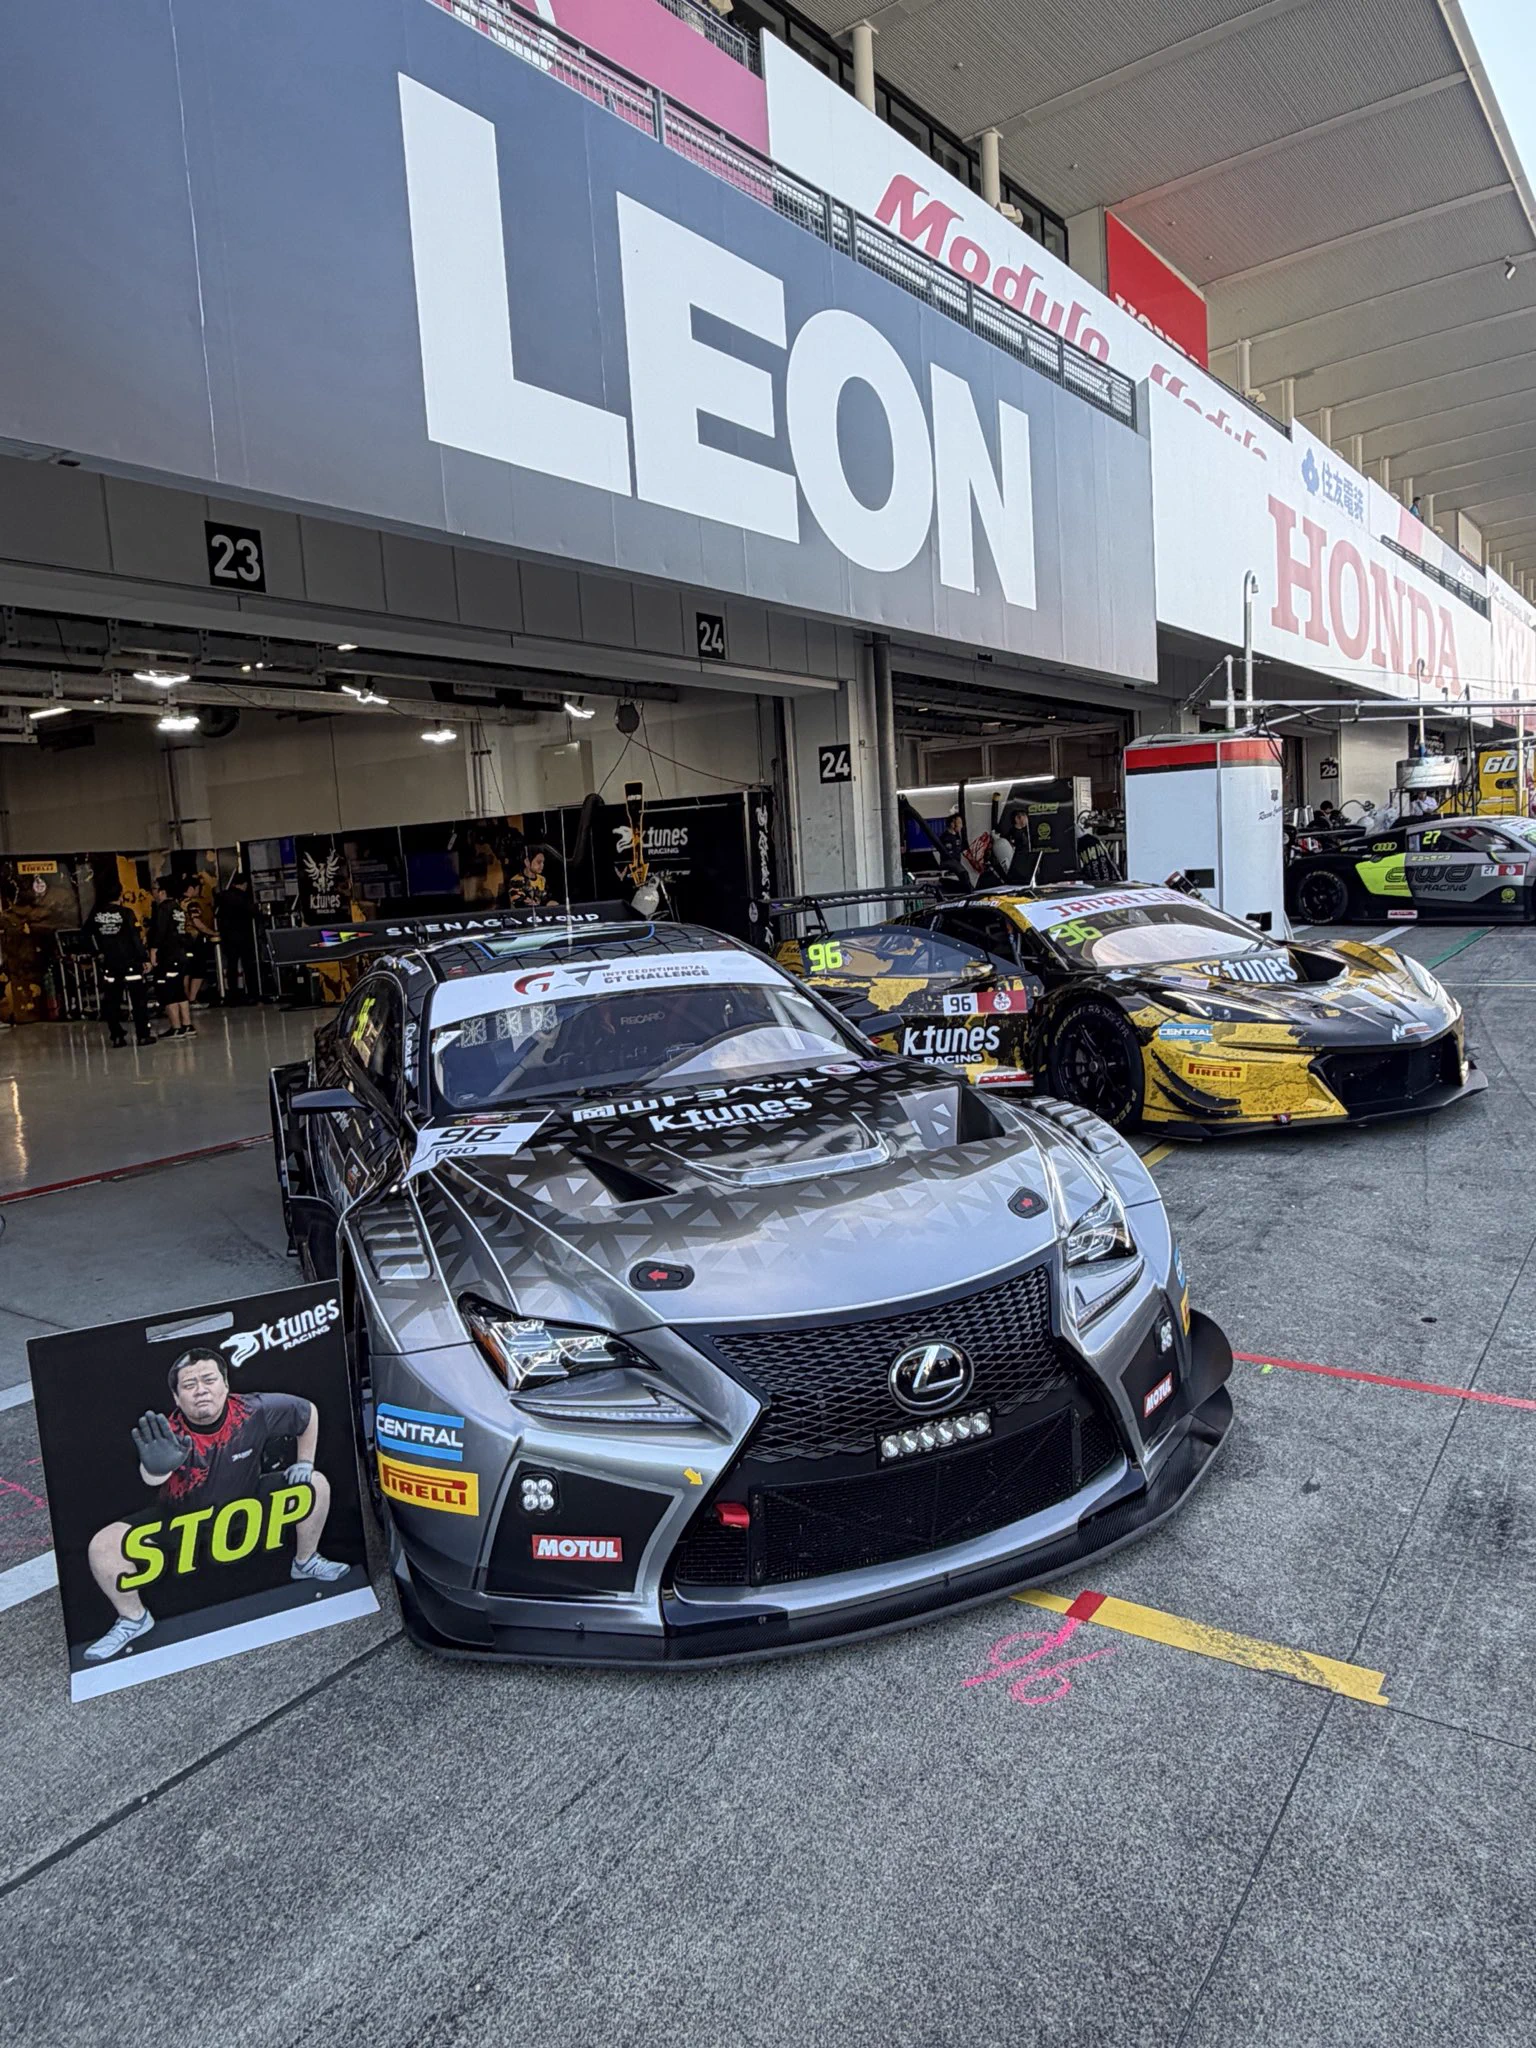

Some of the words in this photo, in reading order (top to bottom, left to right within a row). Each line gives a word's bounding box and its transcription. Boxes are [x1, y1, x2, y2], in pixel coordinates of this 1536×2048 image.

[874, 174, 1110, 363] Modulo
[398, 72, 1036, 611] LEON
[211, 535, 261, 582] 23
[1268, 494, 1462, 695] HONDA
[699, 622, 724, 653] 24
[822, 751, 850, 778] 24
[1483, 753, 1517, 774] 60
[1422, 830, 1441, 845] 27
[648, 847, 680, 855] RACING
[1483, 865, 1495, 875] 27
[1423, 884, 1468, 892] RACING
[1048, 892, 1133, 918] JAPAN
[526, 912, 600, 924] Group
[1048, 920, 1103, 947] 96
[807, 940, 843, 972] 96
[602, 965, 707, 978] INTERCONTINENTAL
[604, 976, 622, 984] GT
[626, 969, 710, 982] CHALLENGE
[950, 996, 972, 1013] 96
[620, 1011, 665, 1025] RECARO
[903, 1025, 1000, 1056] ktunes
[1159, 1027, 1213, 1037] CENTRAL
[924, 1053, 982, 1065] RACING
[1188, 1062, 1242, 1079] PIRELLI
[649, 1096, 813, 1133] ktunes
[694, 1111, 796, 1131] RACING
[431, 1125, 509, 1147] 96
[435, 1146, 478, 1162] PRO
[261, 1298, 339, 1351] ktunes
[283, 1324, 331, 1352] RACING
[1145, 1374, 1173, 1413] MOTUL
[376, 1414, 464, 1448] CENTRAL
[382, 1461, 468, 1506] PIRELLI
[120, 1483, 316, 1591] STOP
[536, 1538, 619, 1560] MOTUL
